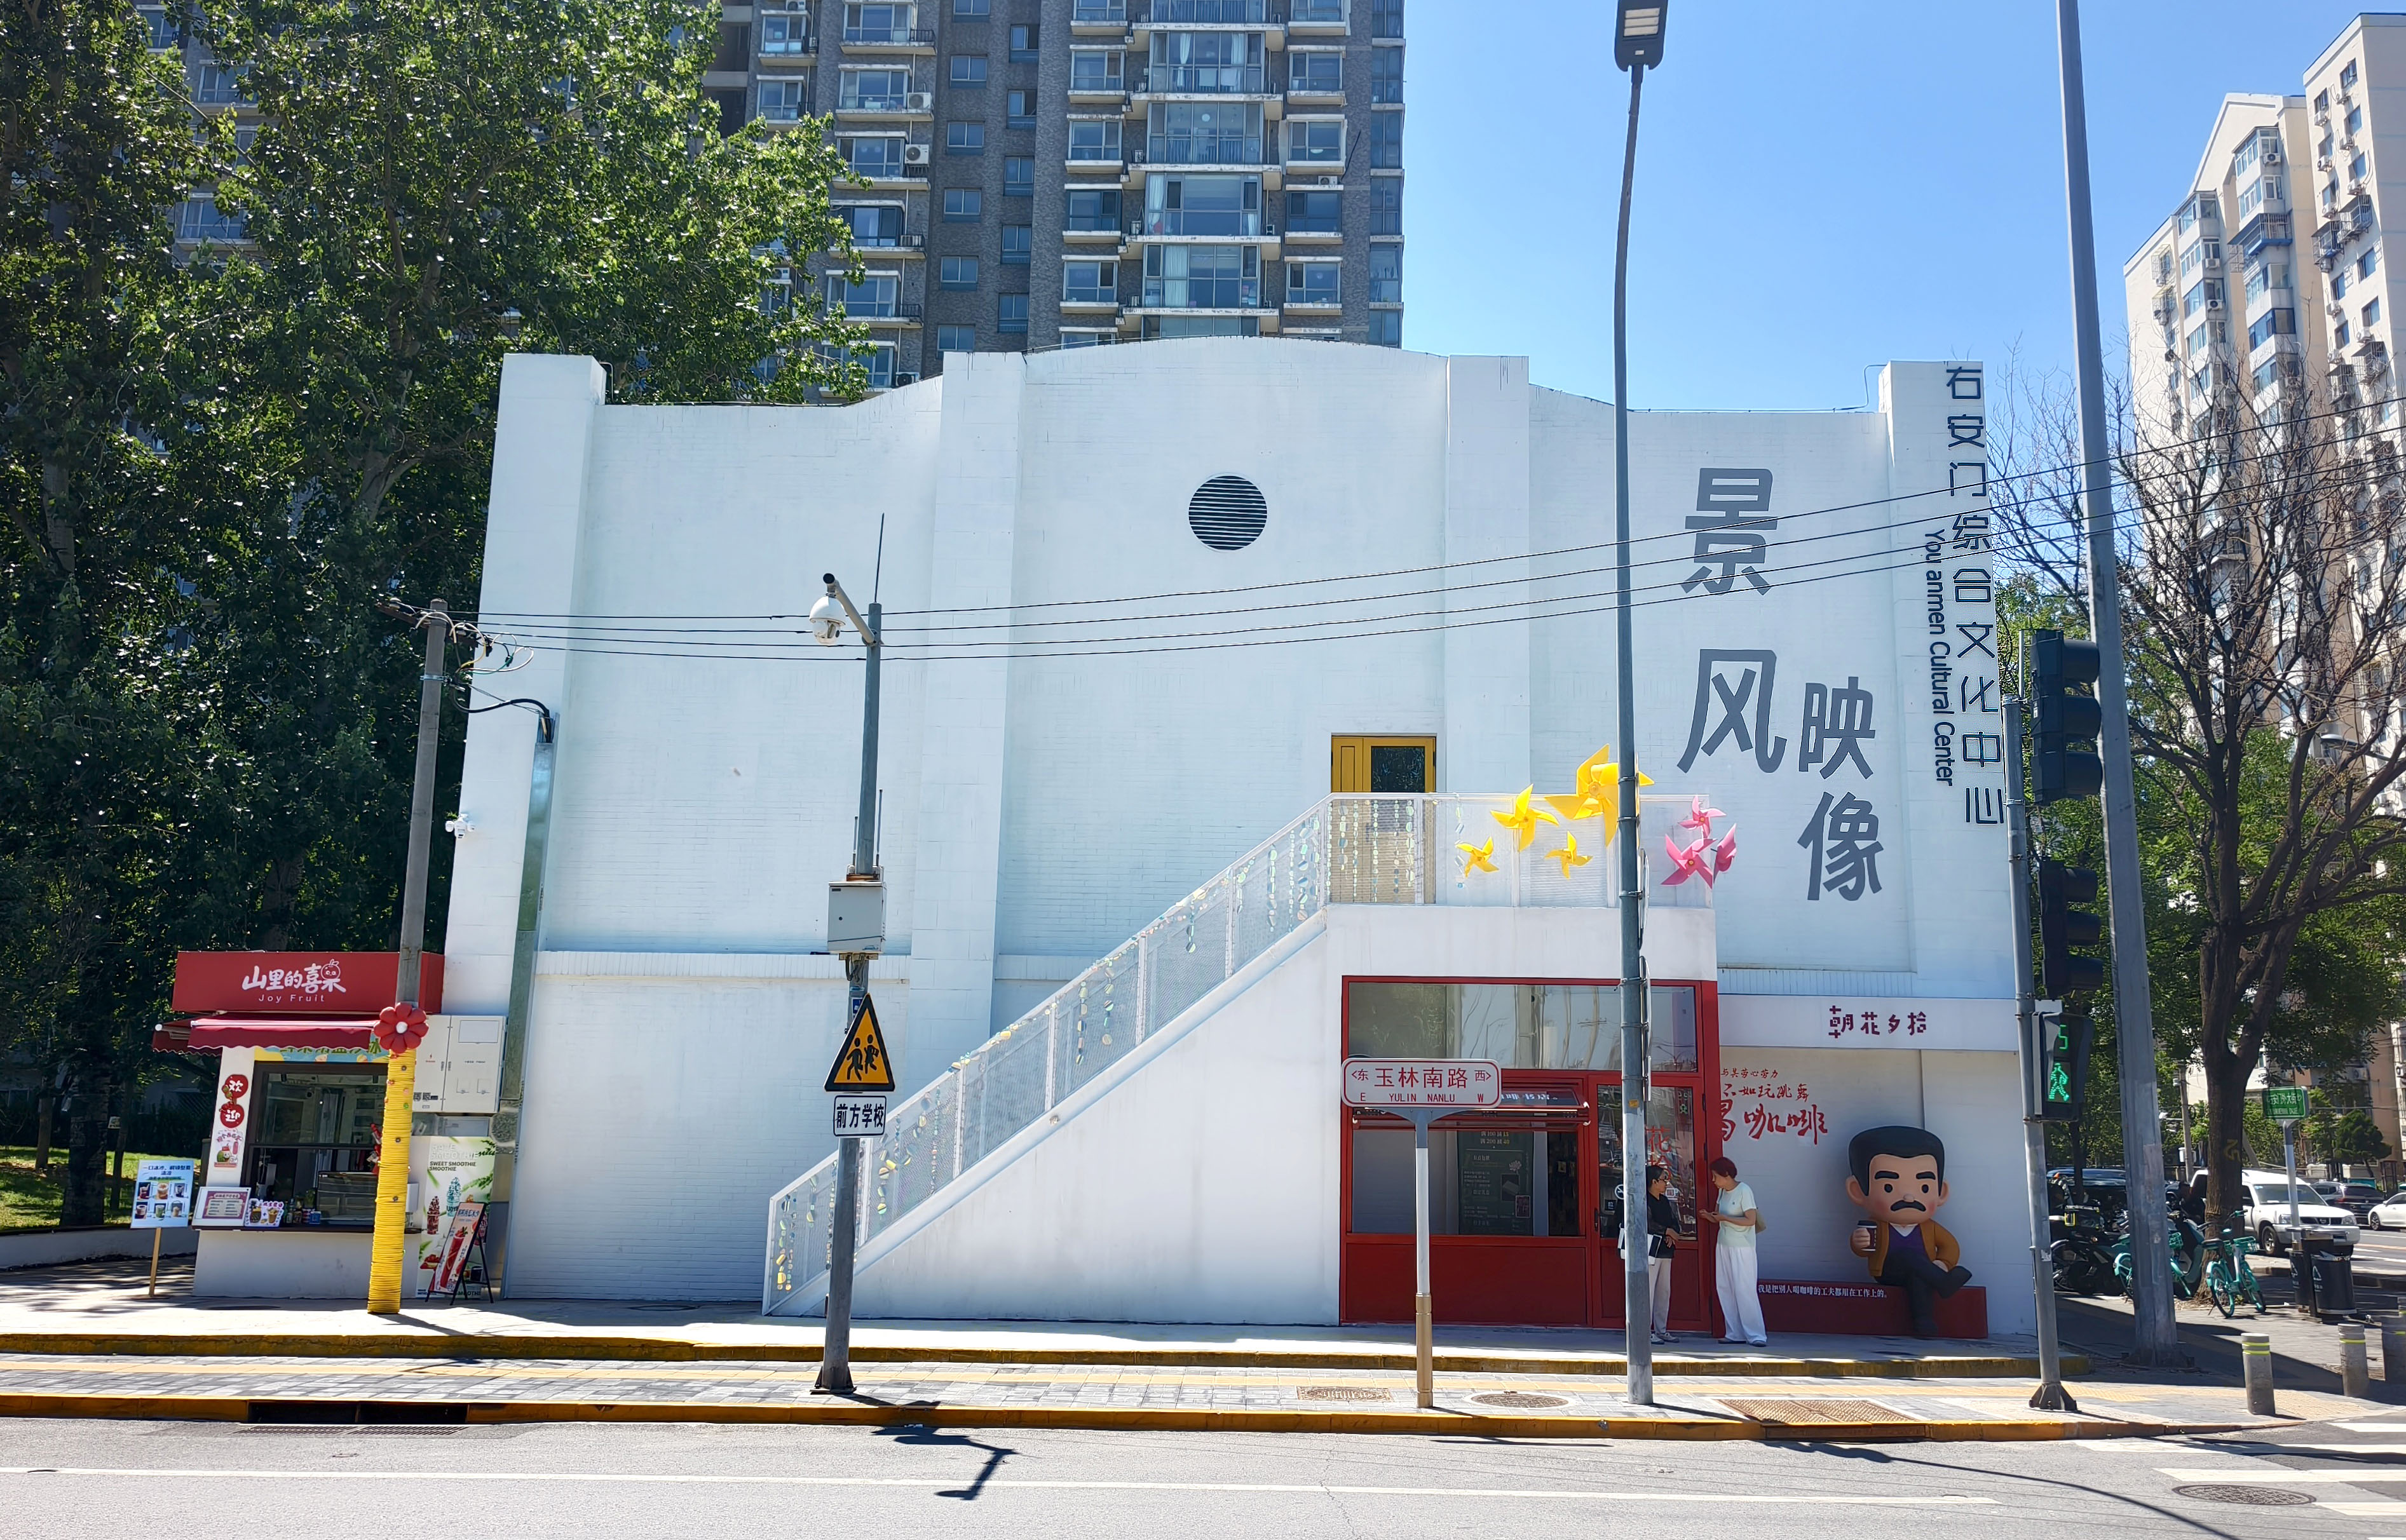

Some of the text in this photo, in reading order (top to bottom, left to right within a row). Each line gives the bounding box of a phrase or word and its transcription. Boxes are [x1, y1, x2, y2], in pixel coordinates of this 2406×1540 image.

[1946, 366, 2004, 824] 右安门综合文化中心
[1929, 641, 1955, 714] Cultural
[1933, 721, 1956, 787] Center
[241, 958, 347, 994] 山里的喜果
[258, 994, 325, 1003] Joy Fruit
[1828, 1004, 1927, 1039] 朝花夕拾
[1357, 1067, 1486, 1089] 东 玉林南路 西
[1360, 1093, 1484, 1103] E YULIN NANLU W
[836, 1104, 884, 1128] 前方学校
